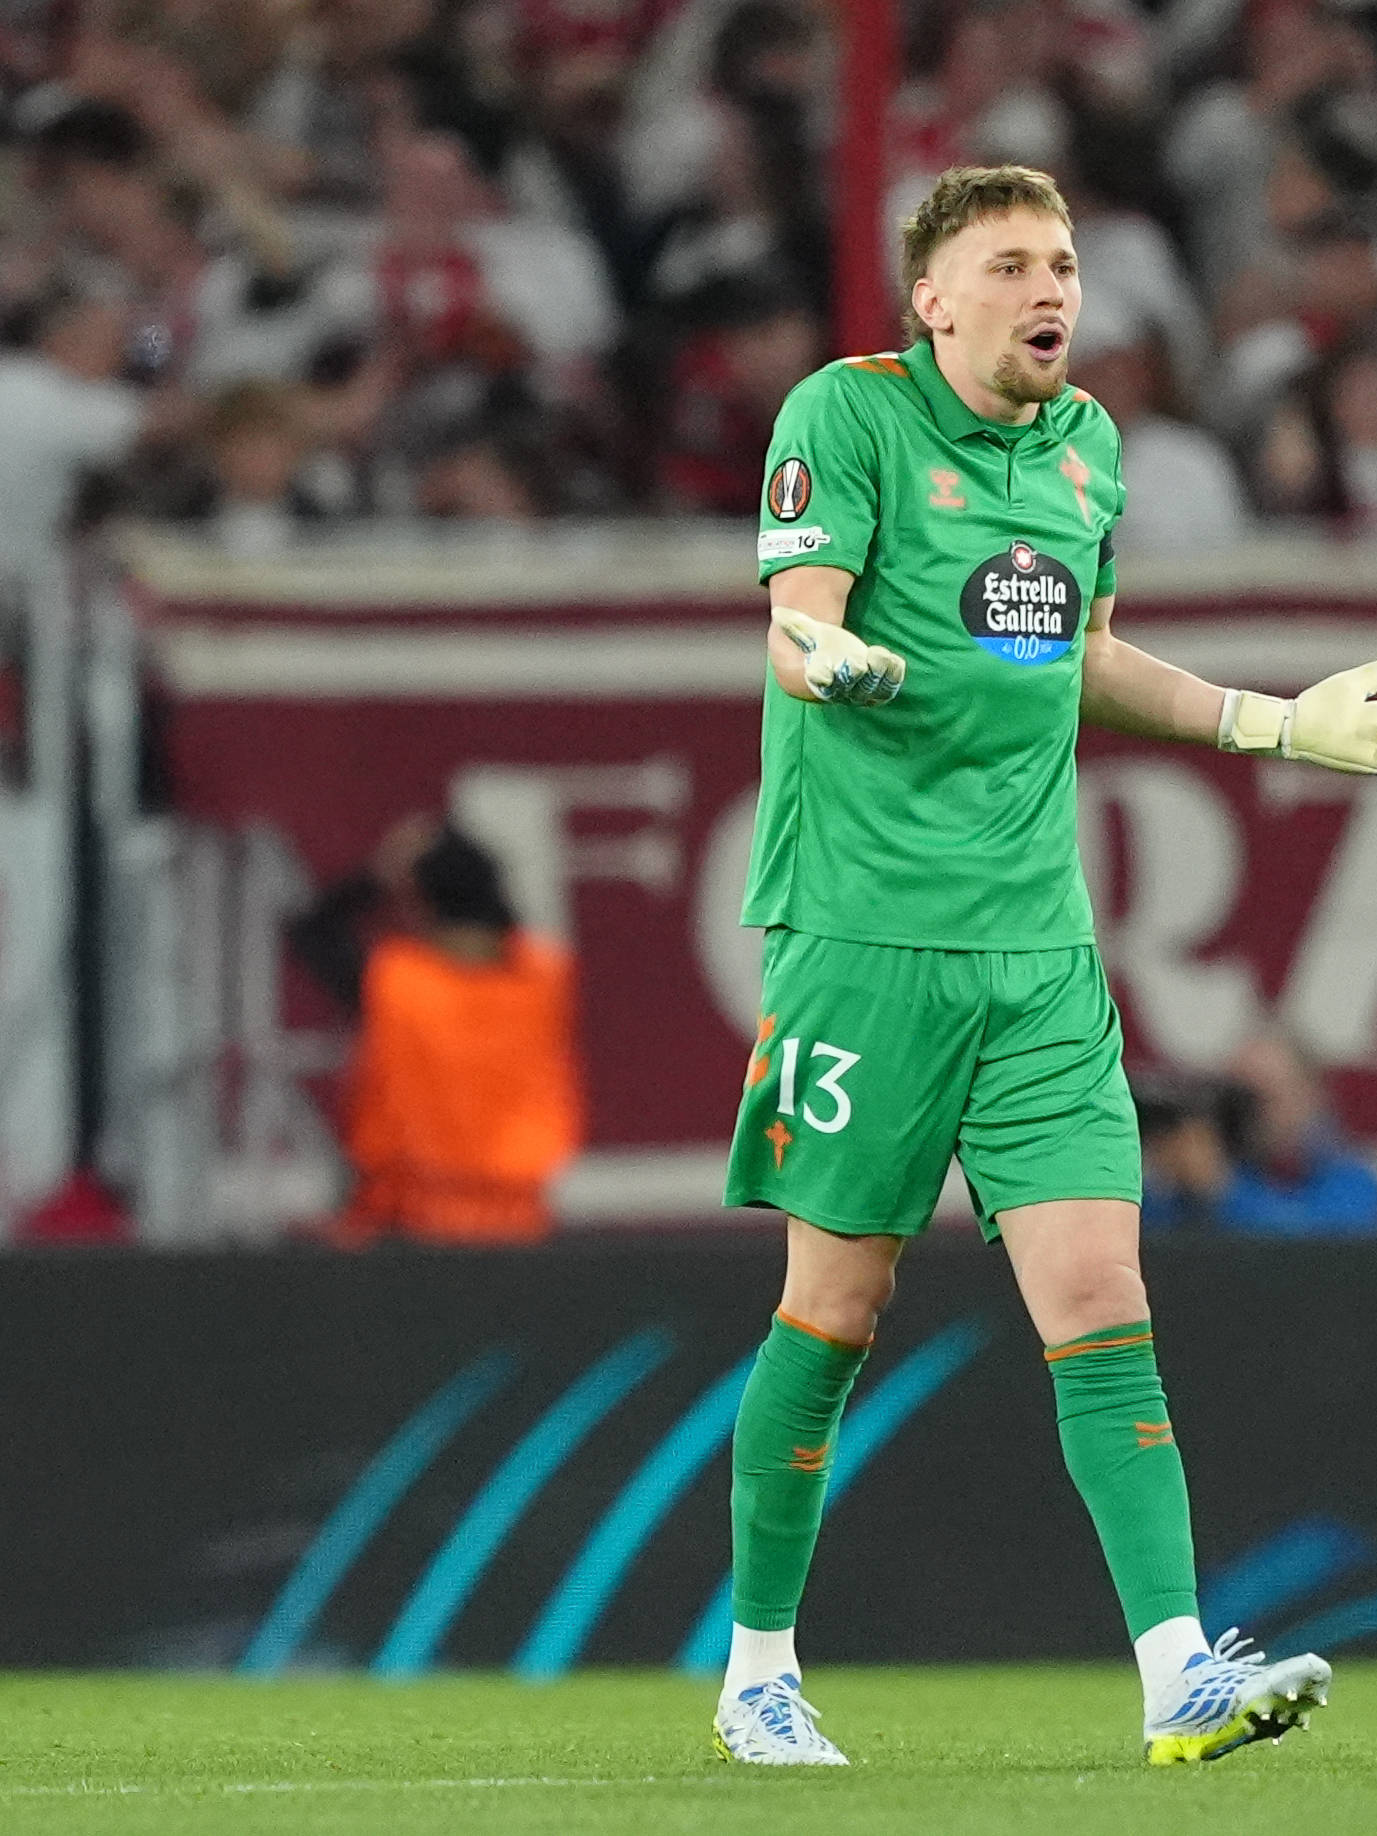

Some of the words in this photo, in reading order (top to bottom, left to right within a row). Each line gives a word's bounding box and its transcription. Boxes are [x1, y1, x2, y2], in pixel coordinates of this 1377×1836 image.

[982, 571, 1067, 604] Estrella
[986, 601, 1062, 633] Galicia
[776, 1037, 862, 1134] 13
